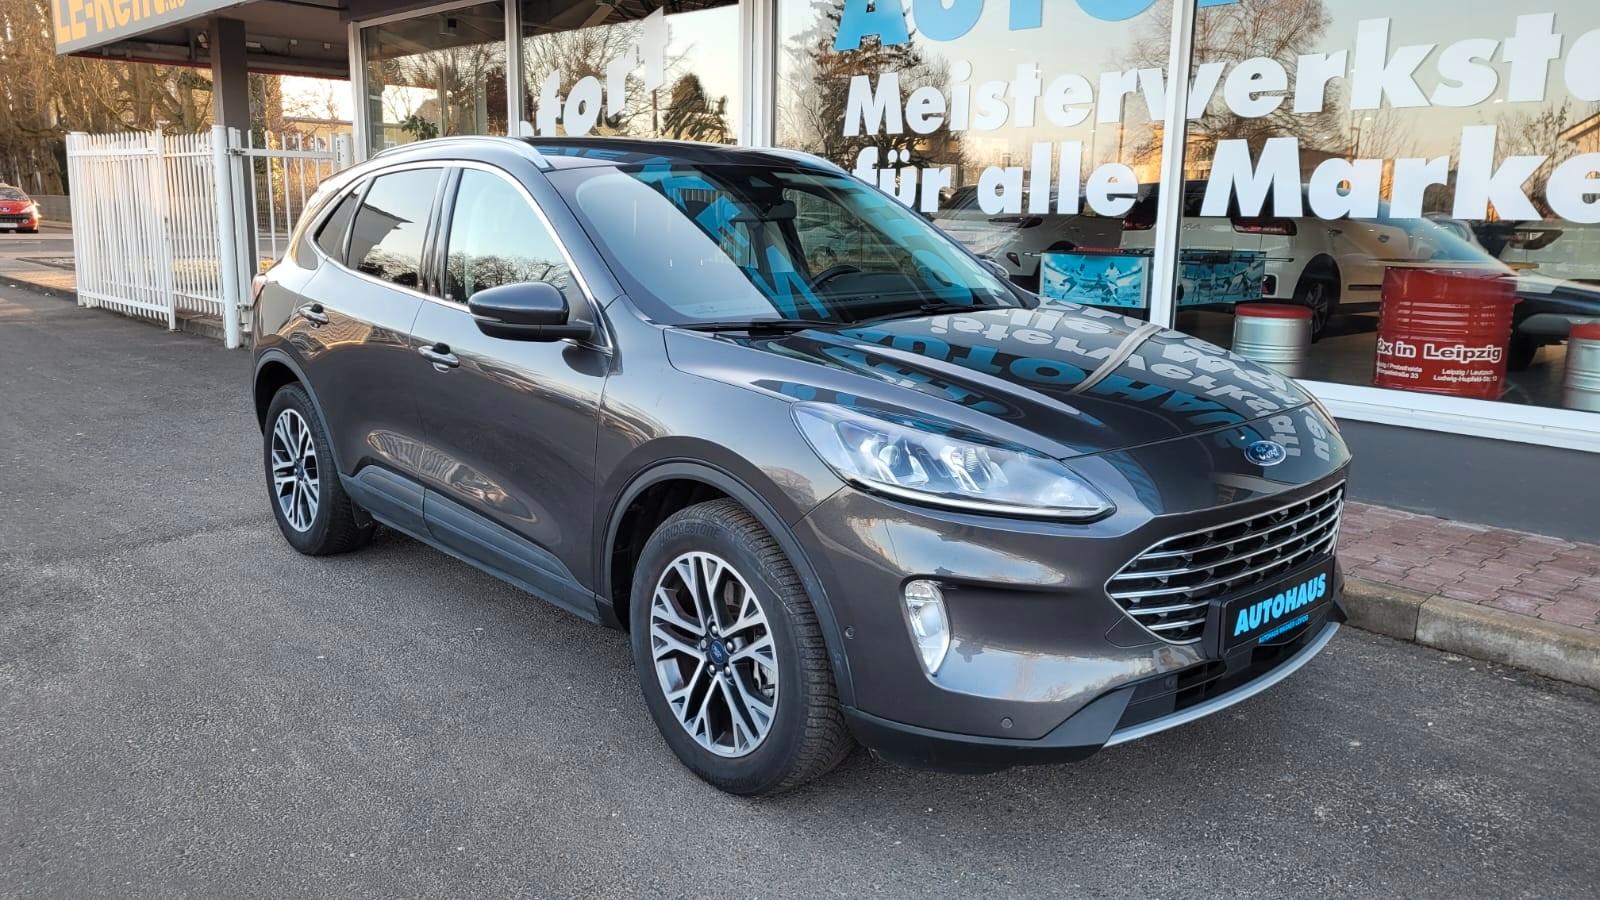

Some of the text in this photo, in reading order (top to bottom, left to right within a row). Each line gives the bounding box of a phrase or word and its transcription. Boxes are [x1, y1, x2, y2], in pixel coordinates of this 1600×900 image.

[854, 125, 1600, 224] für alle Marke
[1395, 340, 1417, 358] in
[1424, 344, 1502, 363] Leipzig
[1234, 572, 1326, 637] AUTOHAUS
